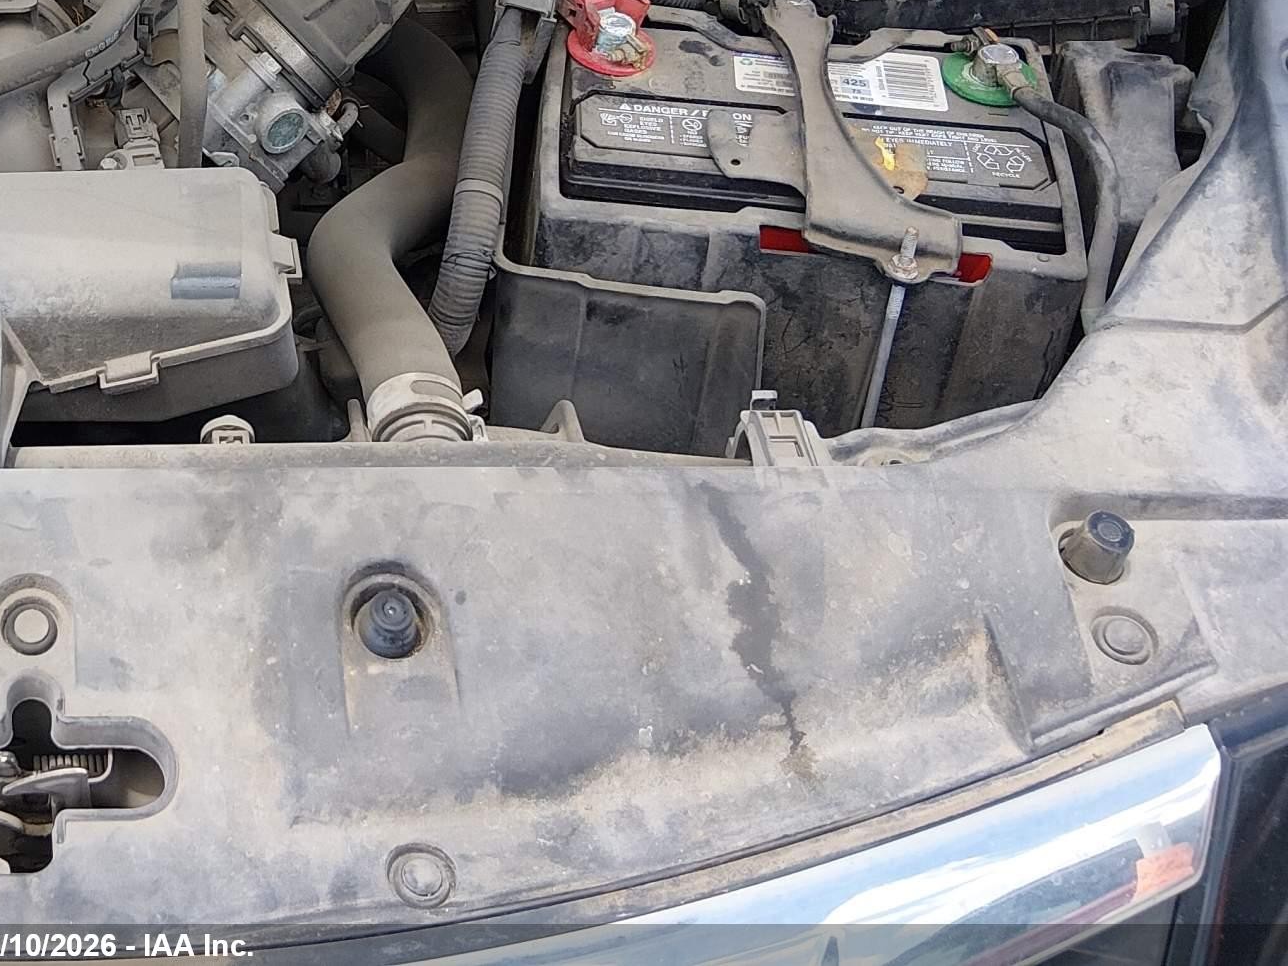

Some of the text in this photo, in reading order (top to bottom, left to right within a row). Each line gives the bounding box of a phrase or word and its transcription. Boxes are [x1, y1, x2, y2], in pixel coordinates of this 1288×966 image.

[842, 78, 867, 87] 425
[633, 104, 689, 116] DANGER
[906, 139, 953, 147] IMMEDIATELY
[991, 171, 1021, 179] RECYCLE
